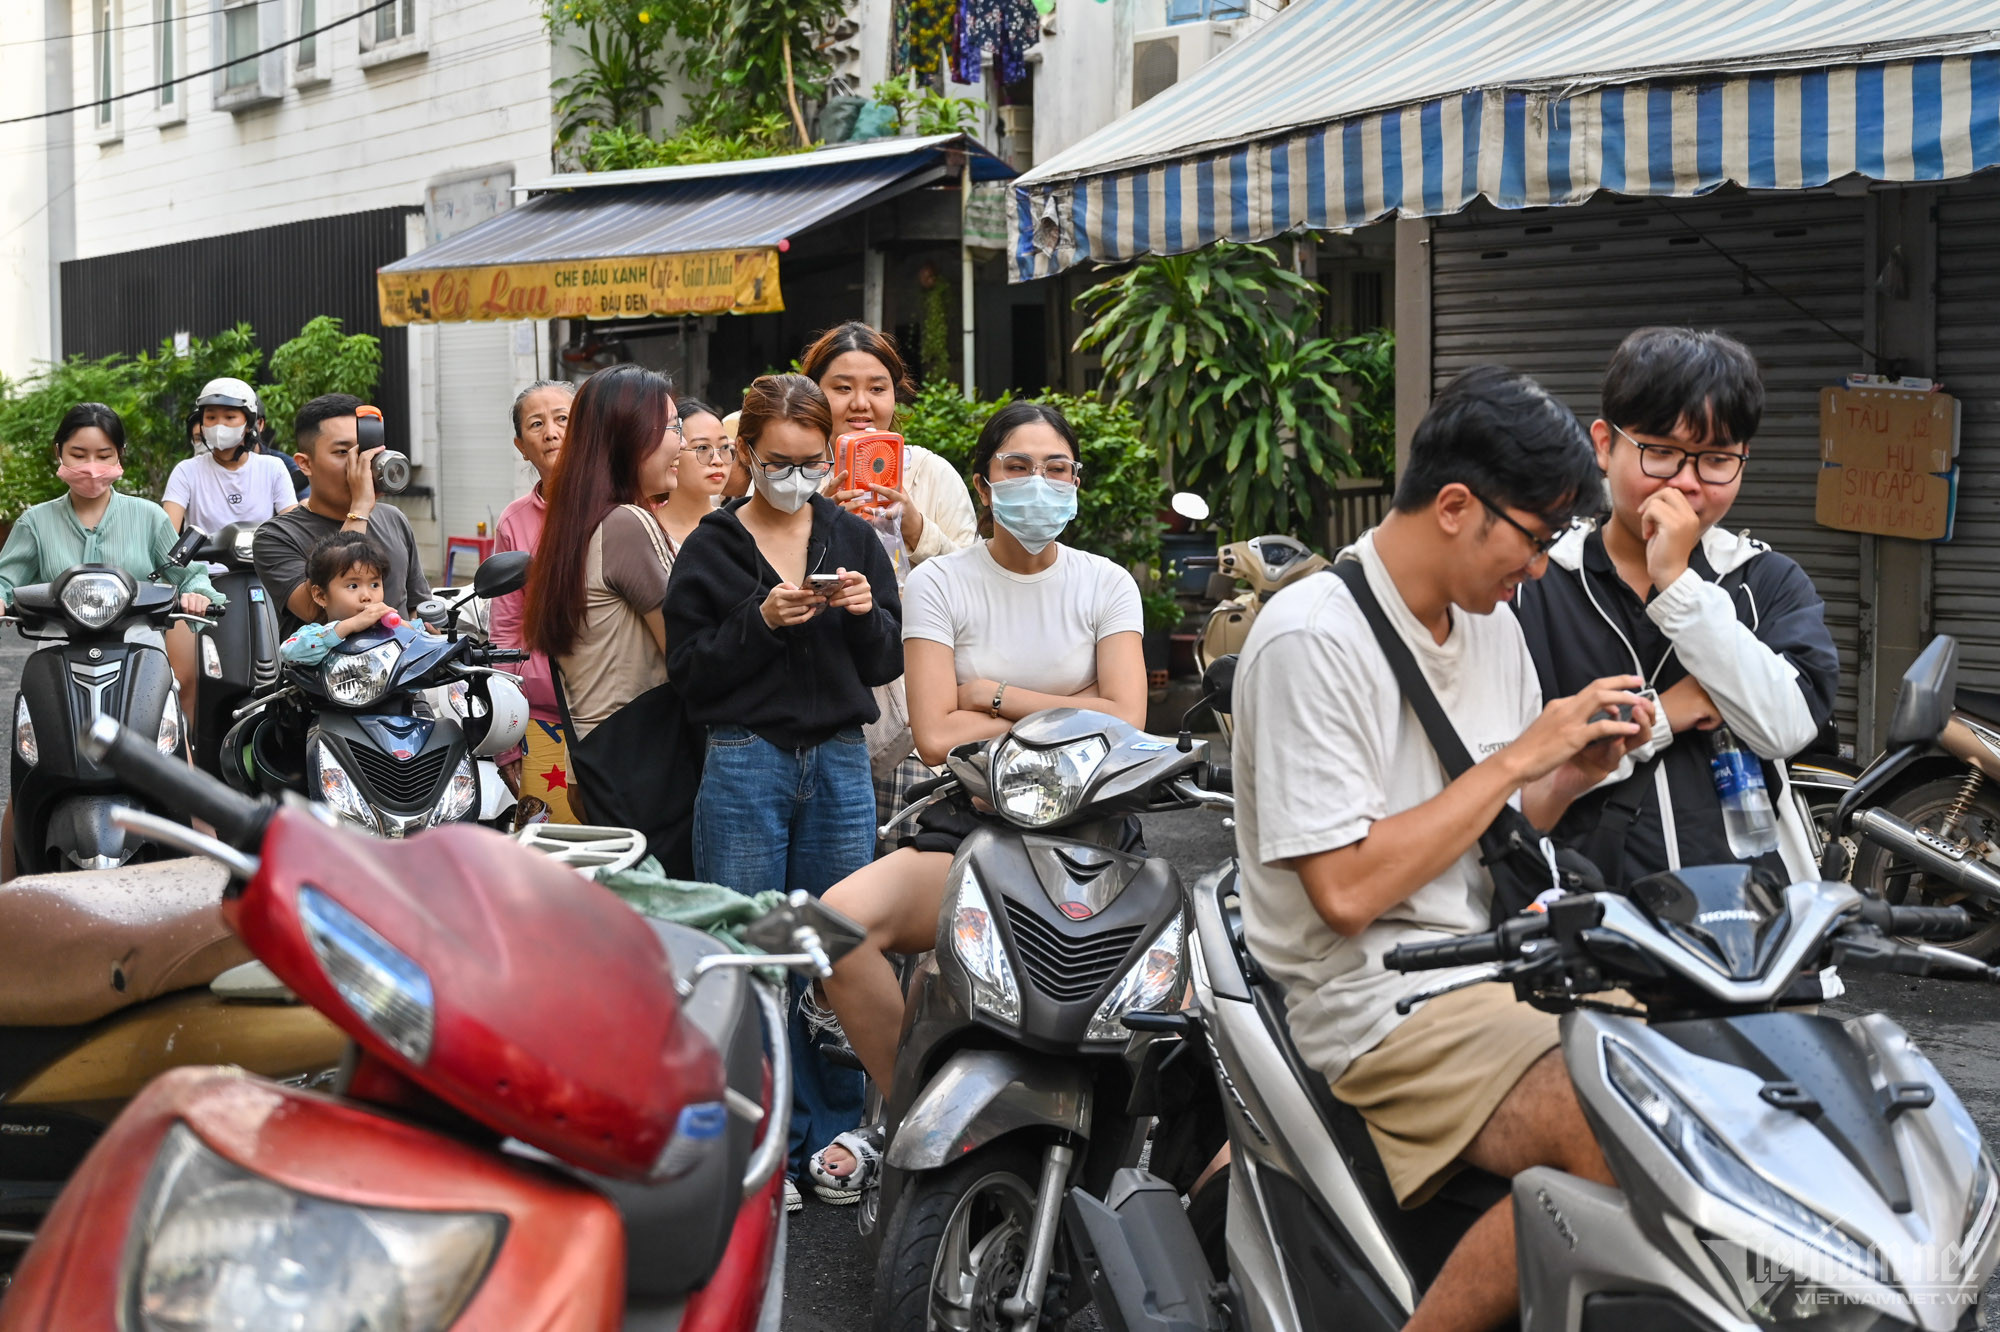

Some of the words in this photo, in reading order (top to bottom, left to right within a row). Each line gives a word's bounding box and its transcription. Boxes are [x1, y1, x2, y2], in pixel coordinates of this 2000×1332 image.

[613, 265, 648, 284] XANH
[432, 272, 470, 318] Cô
[480, 269, 549, 316] Lan
[625, 293, 648, 312] ĐEN
[1845, 467, 1925, 504] SINGAPO
